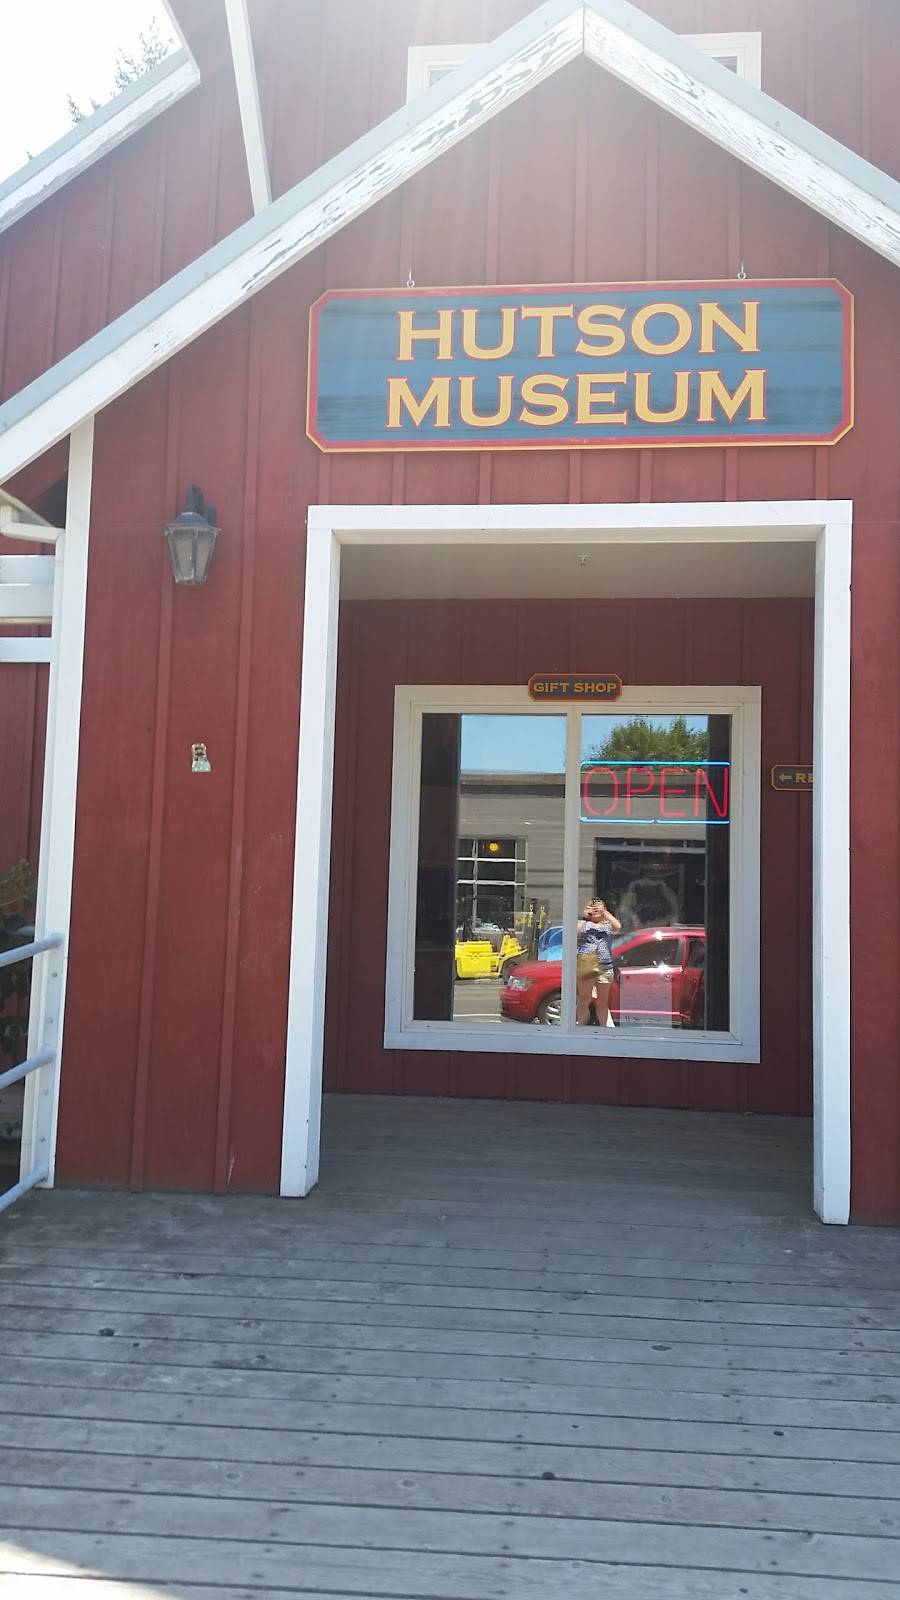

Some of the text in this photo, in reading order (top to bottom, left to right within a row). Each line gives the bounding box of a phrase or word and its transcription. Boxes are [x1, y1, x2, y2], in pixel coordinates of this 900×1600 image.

[396, 301, 761, 361] HUTSON
[385, 368, 767, 429] MUSEUM
[533, 682, 617, 693] GIFT SHOP
[582, 766, 729, 818] OPEN
